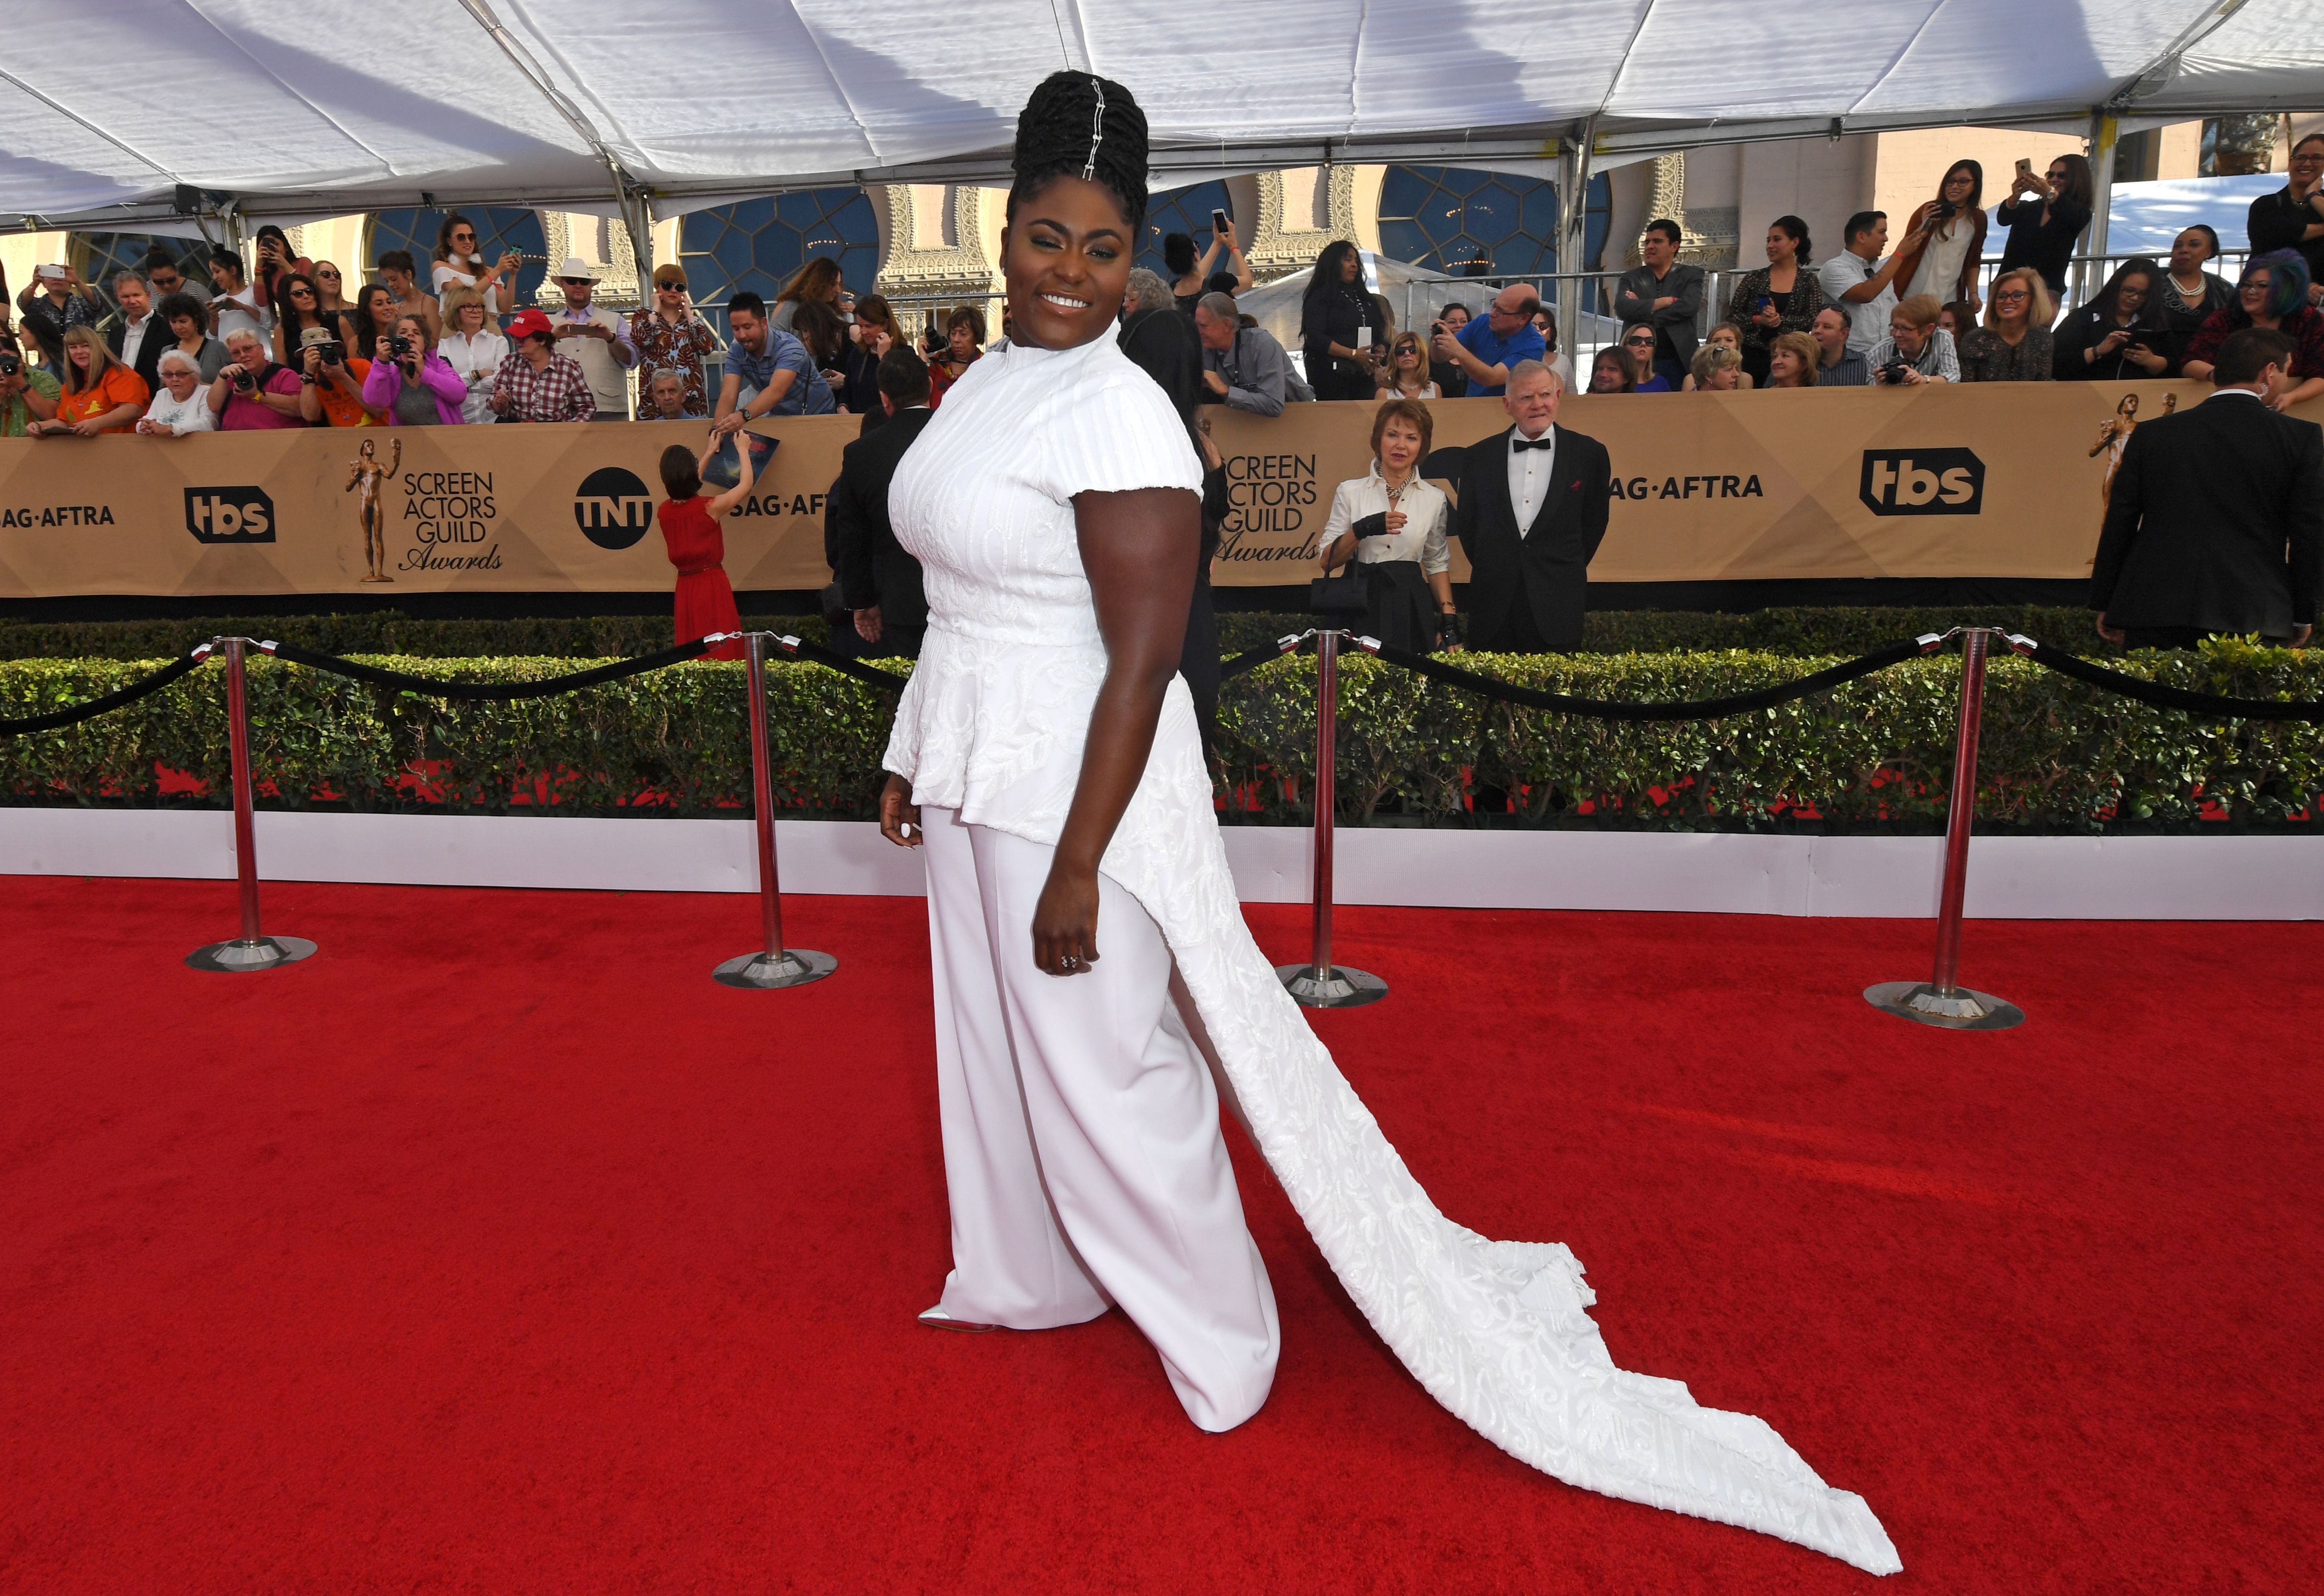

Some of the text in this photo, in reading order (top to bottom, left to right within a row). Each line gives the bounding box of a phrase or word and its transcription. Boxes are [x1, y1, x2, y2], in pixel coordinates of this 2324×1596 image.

[1223, 454, 1315, 480] CREEN
[404, 472, 493, 495] SCREEN
[1228, 480, 1317, 506] CTORS
[1609, 474, 1763, 499] AG·AFTRA
[1871, 459, 1974, 505] tbs
[0, 506, 115, 527] AG·AFTRA
[192, 496, 268, 535] tbs
[404, 496, 496, 519] ACTORS
[575, 496, 652, 527] TNT
[1221, 508, 1302, 532] GUILD
[416, 521, 485, 543] GUILD
[398, 541, 503, 571] Awards
[1215, 530, 1319, 561] Awards
